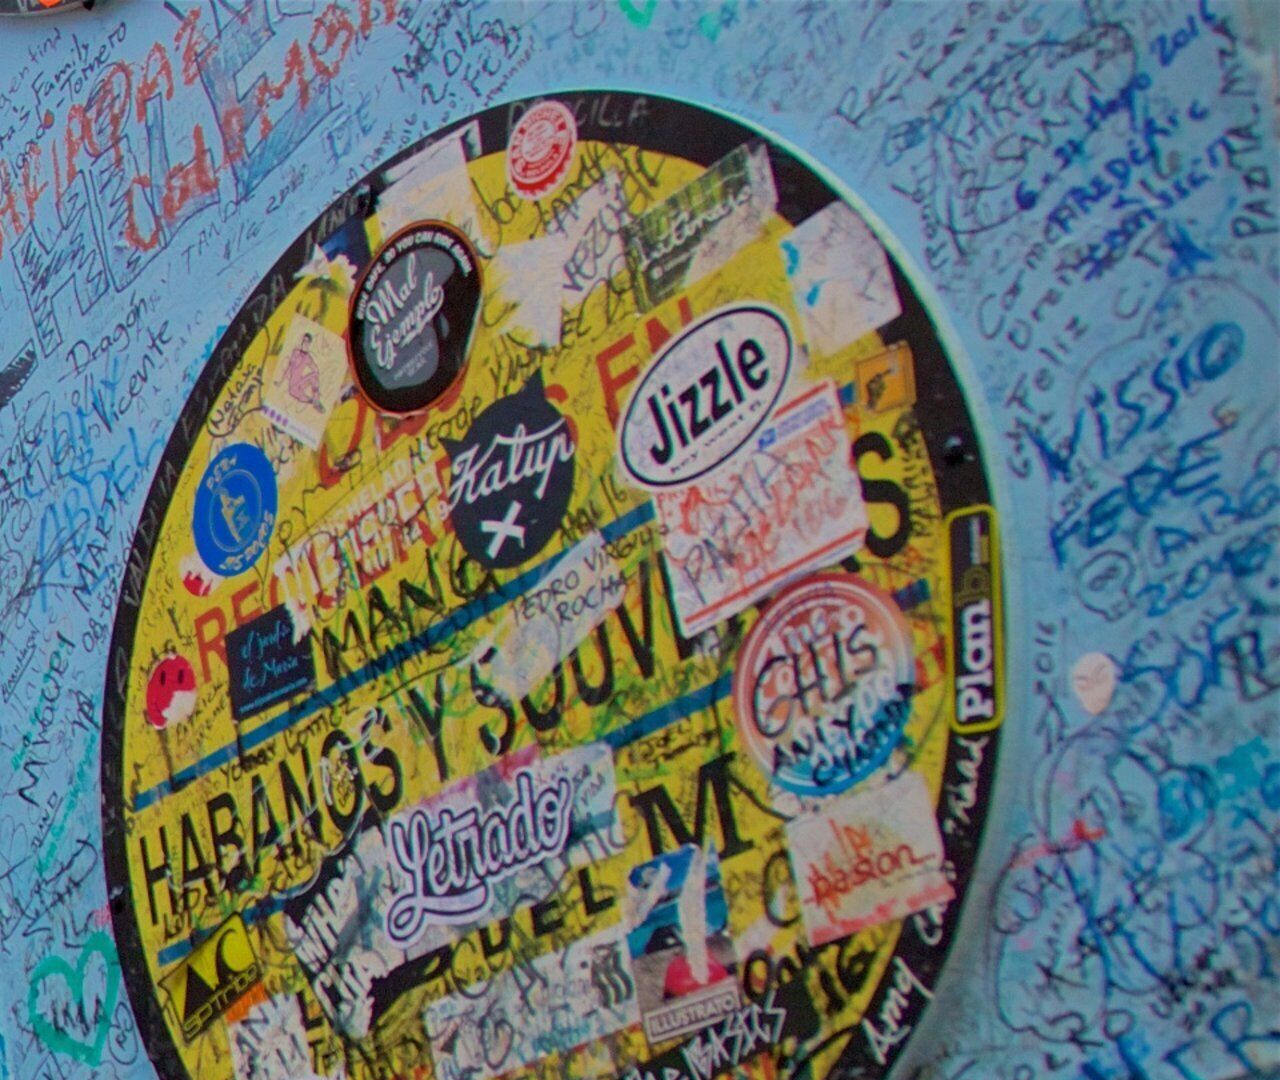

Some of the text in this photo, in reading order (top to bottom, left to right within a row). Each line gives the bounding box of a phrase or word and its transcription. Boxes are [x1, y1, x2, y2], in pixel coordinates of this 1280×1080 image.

[365, 252, 418, 325] Mal
[370, 271, 445, 371] Ejemplo
[649, 338, 770, 466] Jizzle
[955, 598, 994, 723] Plan
[139, 706, 404, 927] HABANOS
[387, 769, 573, 949] Letrado
